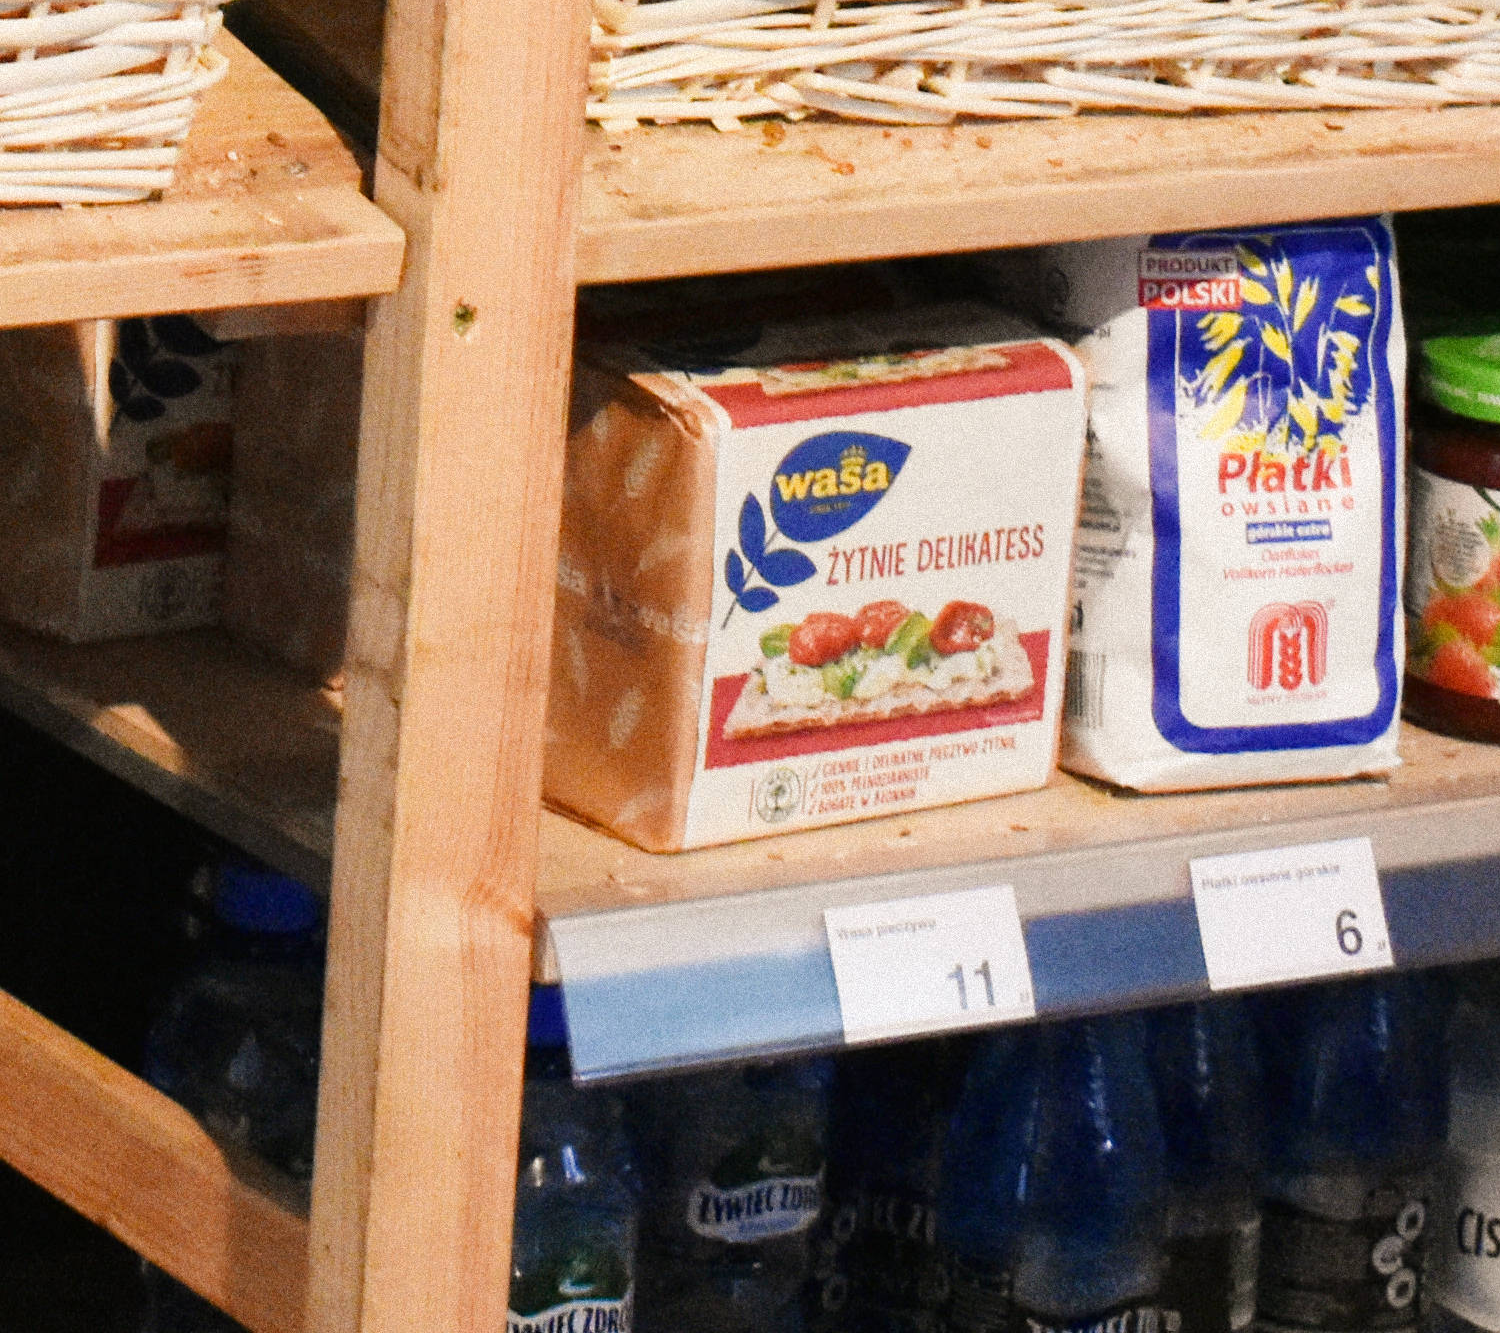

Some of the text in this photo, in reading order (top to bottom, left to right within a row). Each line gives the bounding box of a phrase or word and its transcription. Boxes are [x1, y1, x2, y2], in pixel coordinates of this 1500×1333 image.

[1145, 257, 1236, 275] PRODUKT
[1144, 278, 1239, 307] POLSKI
[774, 461, 890, 503] wasa
[1217, 443, 1354, 495] Płatki
[1220, 495, 1356, 518] owsiane
[826, 523, 1046, 587] ŻYTNIE DELIKATESS
[1335, 907, 1364, 958] 6
[946, 959, 997, 1012] 11
